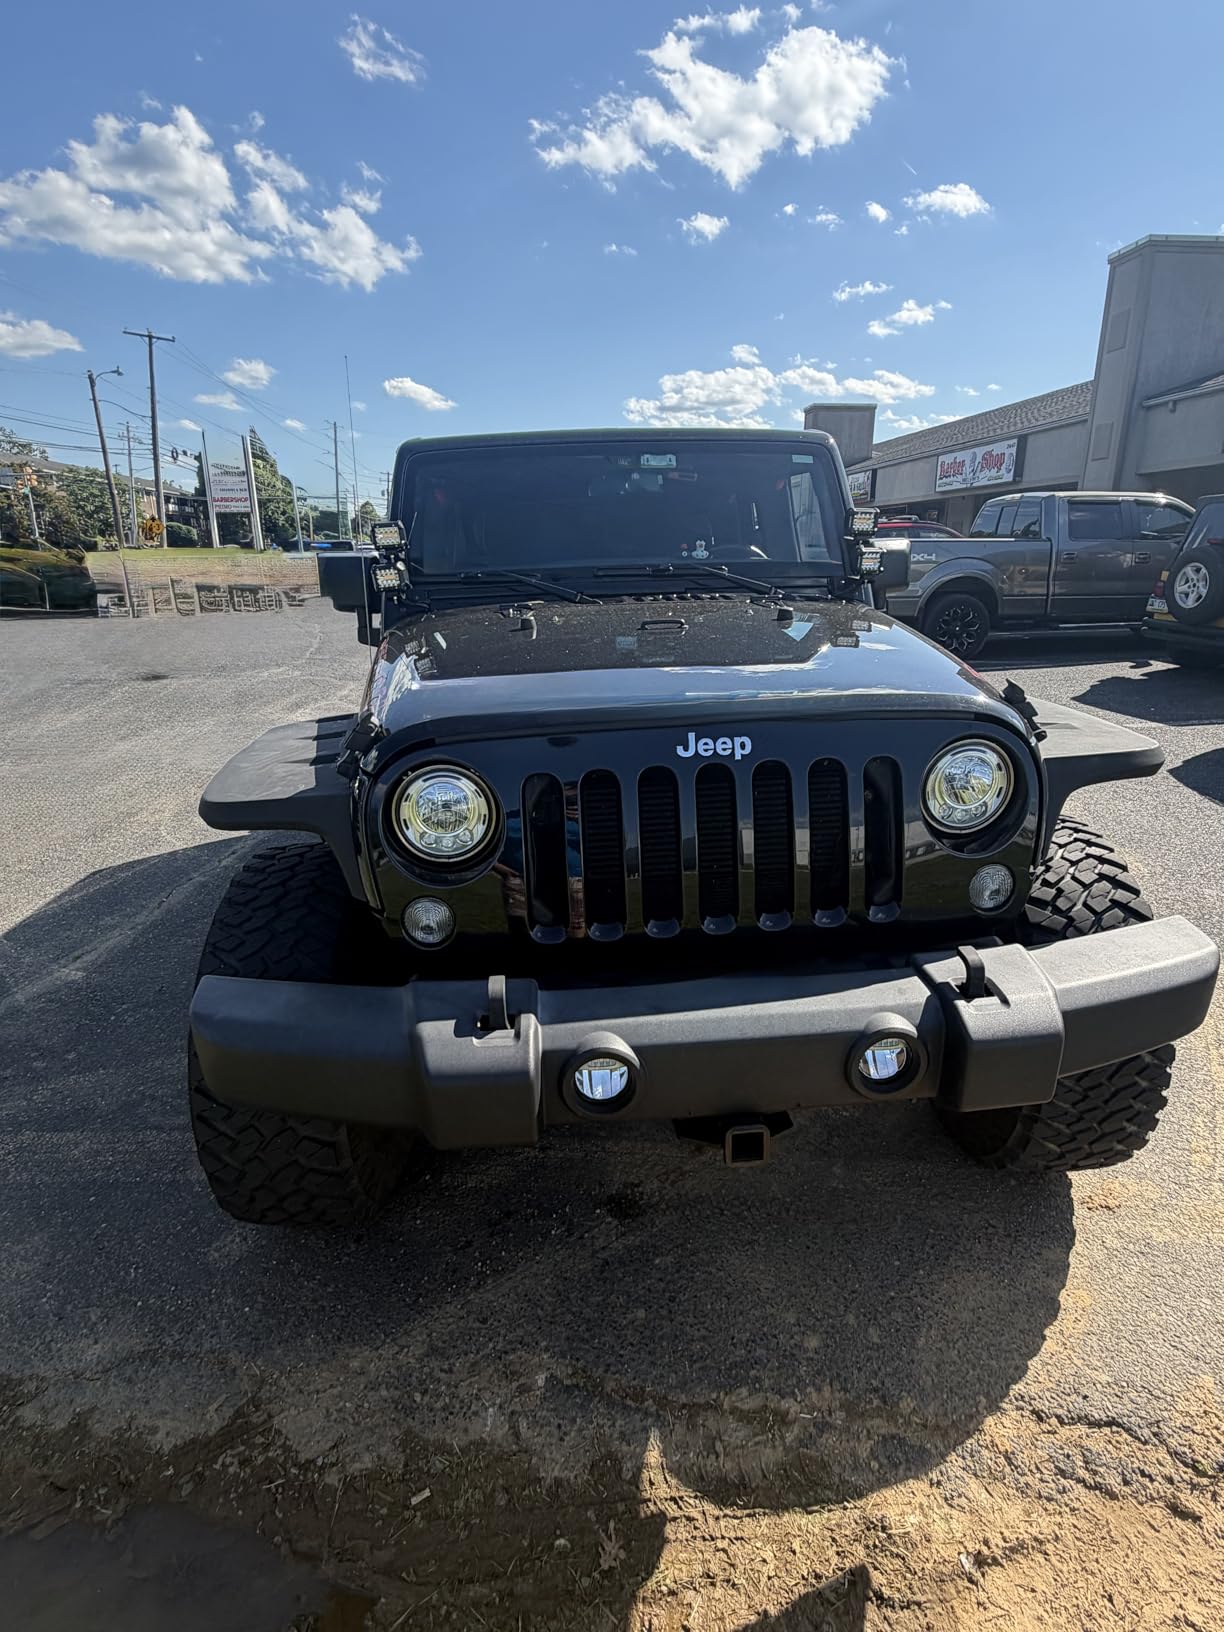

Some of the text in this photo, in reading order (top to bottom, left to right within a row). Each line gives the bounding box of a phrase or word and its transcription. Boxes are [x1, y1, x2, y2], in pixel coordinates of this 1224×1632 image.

[940, 449, 1006, 479] Barber Shop
[676, 732, 752, 760] Jeep
